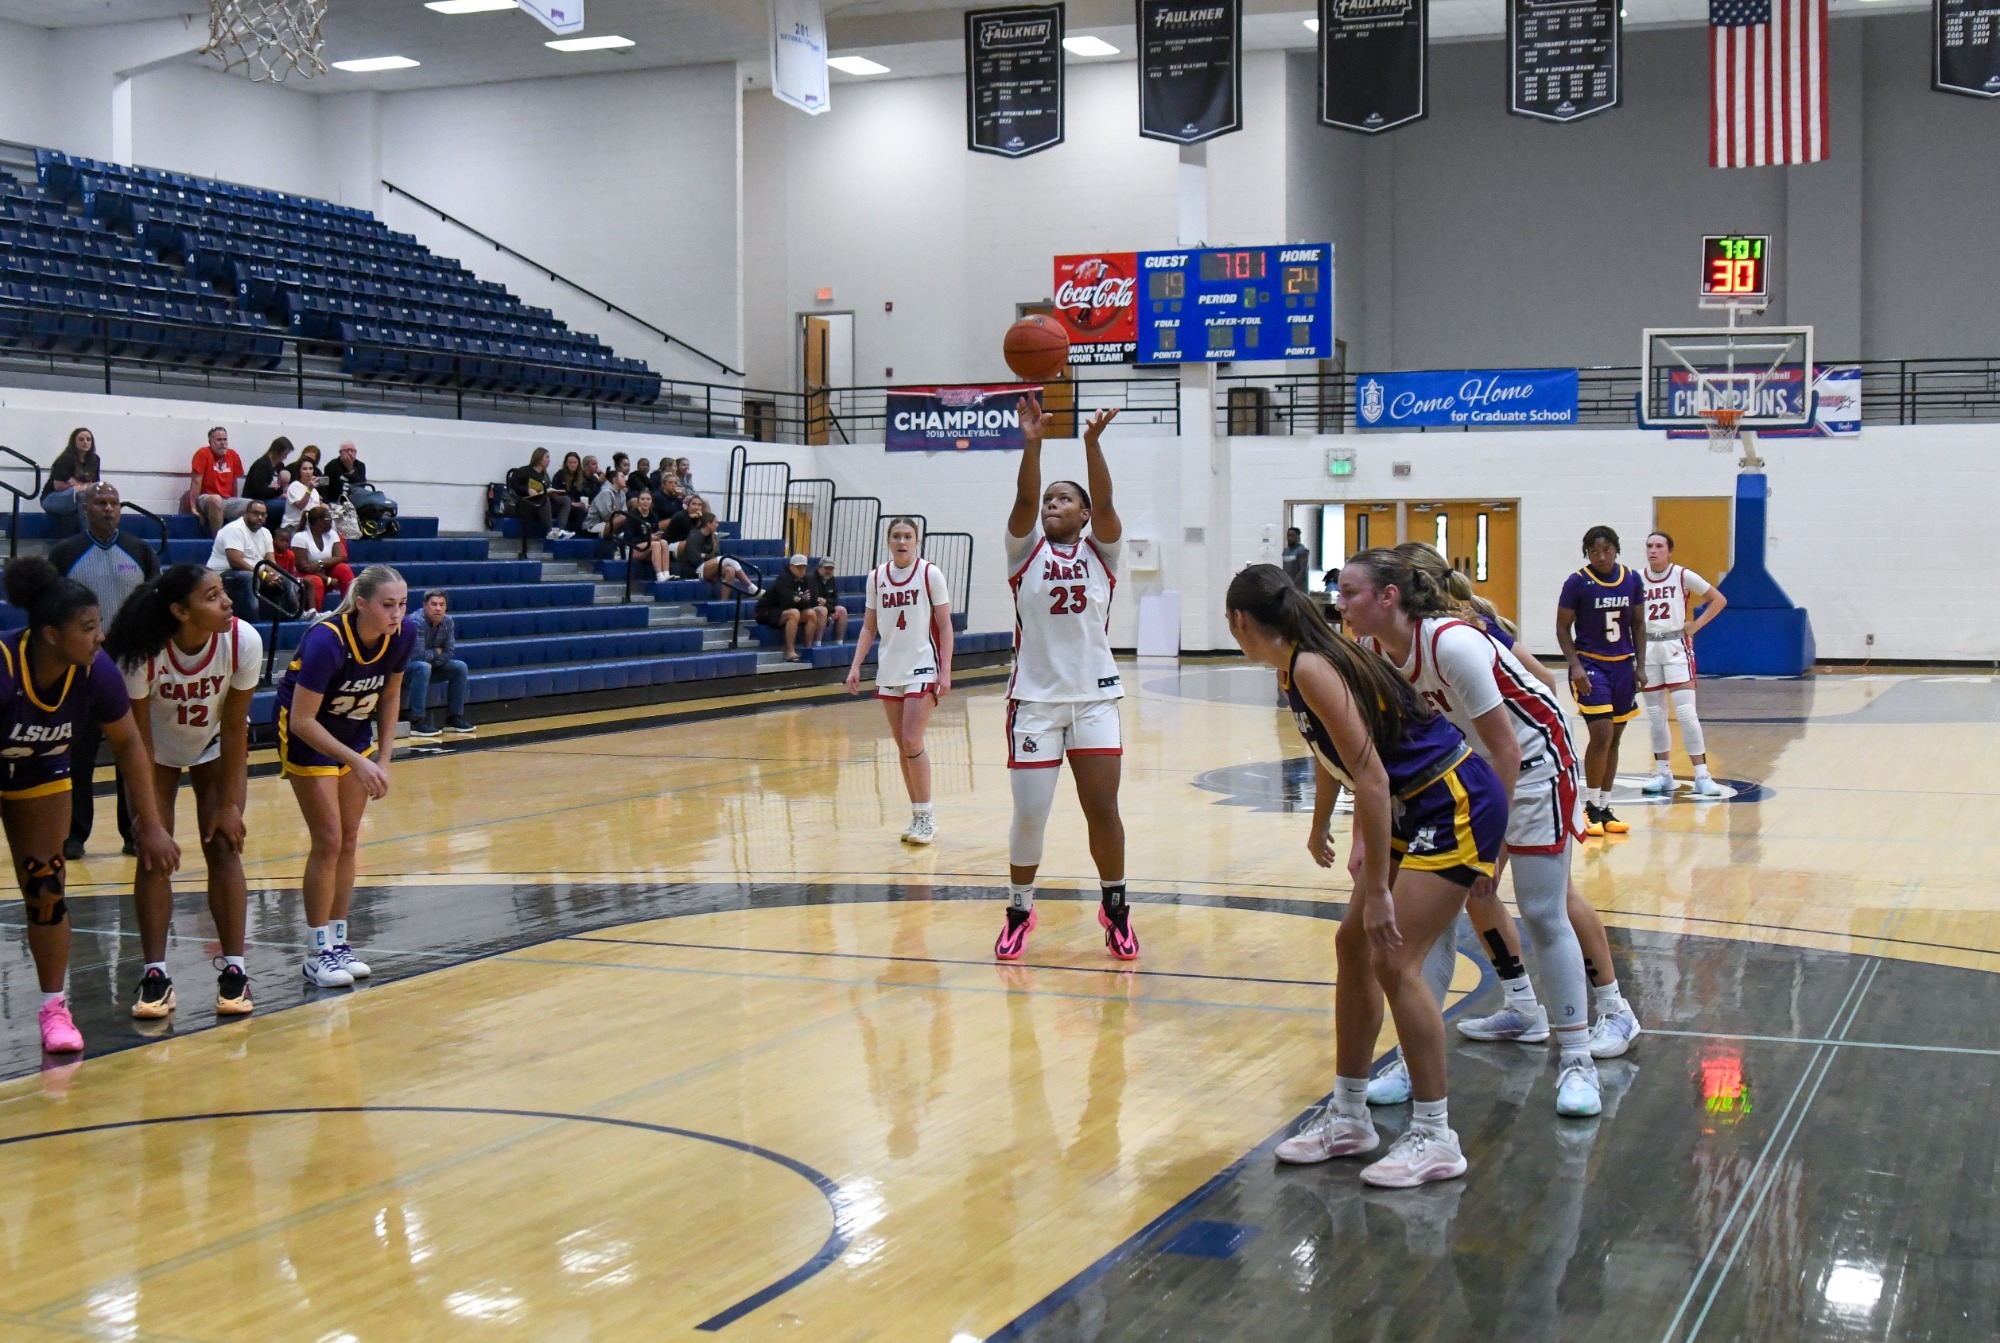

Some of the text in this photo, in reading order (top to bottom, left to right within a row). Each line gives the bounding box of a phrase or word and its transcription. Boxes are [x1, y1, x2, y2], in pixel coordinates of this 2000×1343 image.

[1155, 8, 1224, 27] FAULKNER
[985, 25, 1046, 43] FAULKNER
[40, 167, 46, 177] 7
[137, 223, 143, 234] 5
[1281, 250, 1320, 262] HOME
[1719, 240, 1761, 259] 7:01
[188, 254, 194, 263] 4
[1145, 255, 1188, 268] GUEST
[1288, 267, 1318, 293] 24
[1711, 260, 1754, 292] 30
[241, 283, 247, 294] 3
[1055, 278, 1136, 309] Coca-Cola
[1199, 294, 1237, 304] PERIOD
[294, 314, 300, 324] 2
[1155, 320, 1180, 328] FOULS
[1205, 317, 1262, 326] PLAYER-FOUL
[1287, 315, 1314, 323] FOULS
[1097, 344, 1122, 352] PART
[1124, 343, 1136, 352] OF
[1206, 350, 1235, 358] MATCH
[1285, 347, 1316, 355] POINTS
[1068, 353, 1123, 363] YOUR TEAM!
[1153, 351, 1182, 359] POINTS
[1390, 375, 1535, 420] Come Home
[894, 410, 1019, 430] CHAMPION
[1451, 409, 1571, 421] for Graduate School
[926, 430, 1000, 438] 2018 VOLLEYBALL
[1043, 559, 1090, 581] CAREY
[882, 590, 919, 609] CAREY
[1049, 585, 1087, 614] 23
[1643, 586, 1676, 601] CAREY
[1595, 596, 1630, 609] LSUA
[1648, 603, 1670, 620] 22
[896, 610, 906, 630] 4
[1605, 611, 1621, 643] 5
[160, 676, 224, 702] CAREY
[339, 675, 385, 692] LSUA
[178, 704, 208, 727] 12
[9, 723, 72, 741] LSUA
